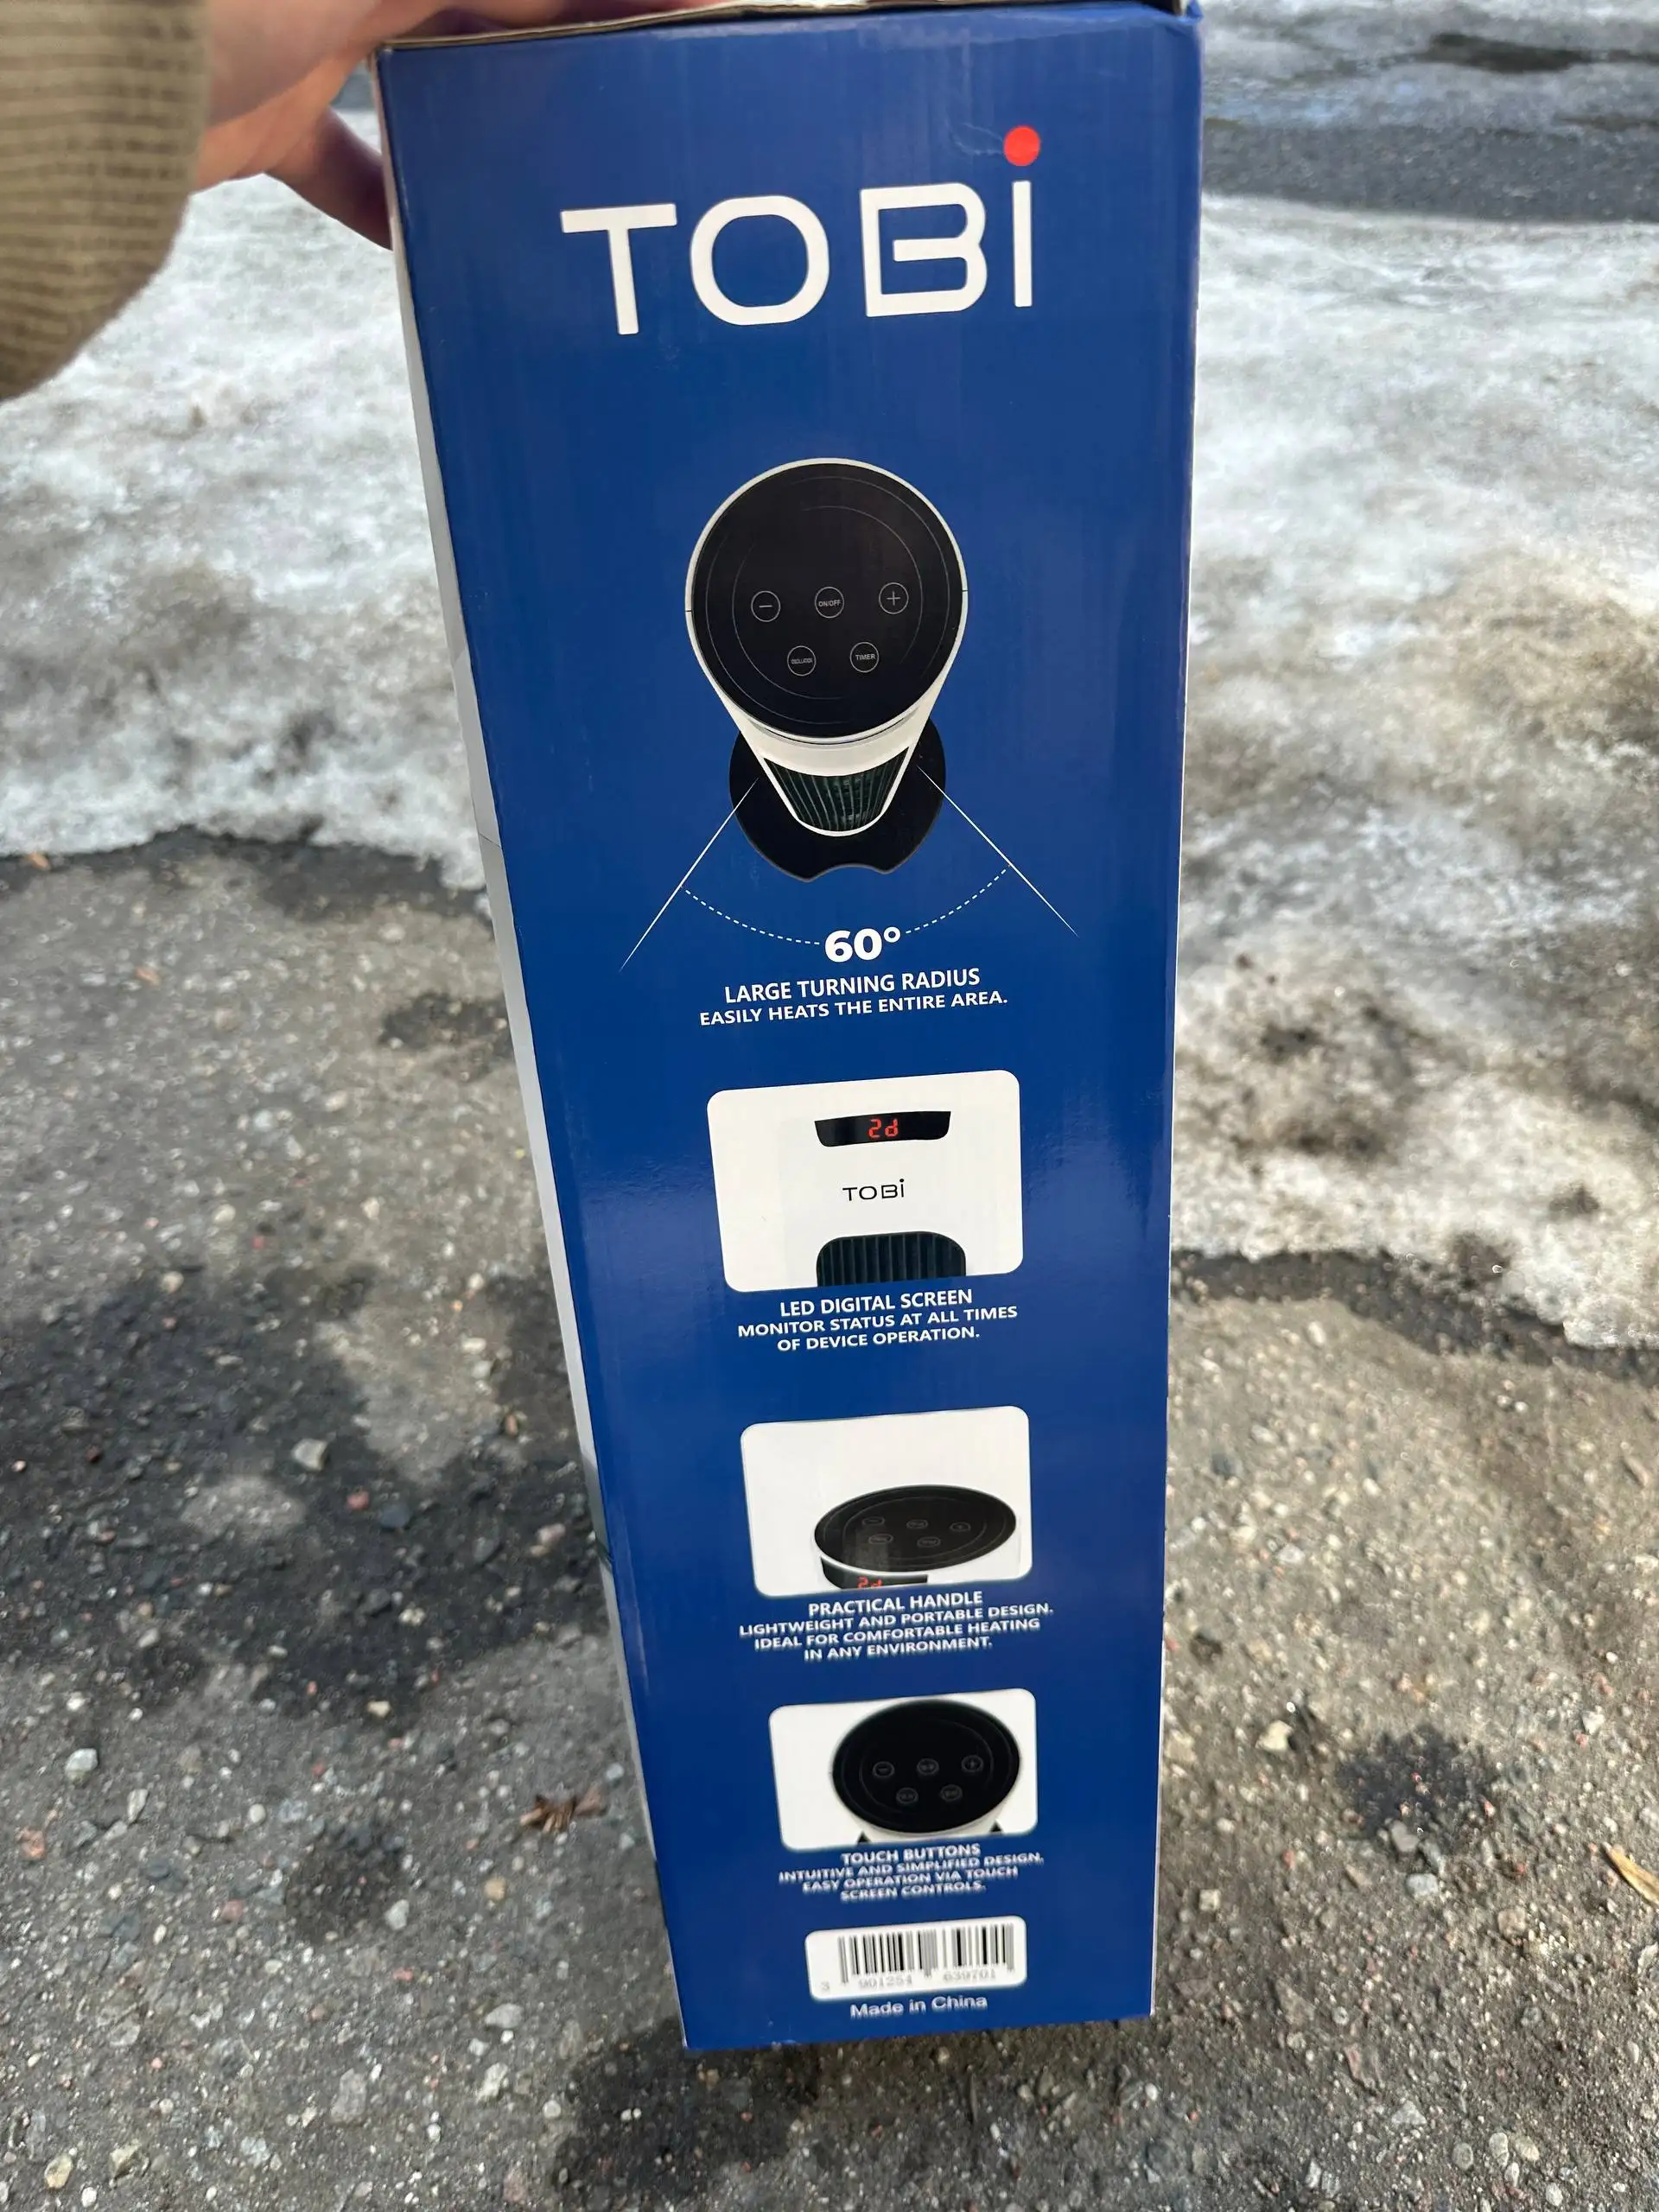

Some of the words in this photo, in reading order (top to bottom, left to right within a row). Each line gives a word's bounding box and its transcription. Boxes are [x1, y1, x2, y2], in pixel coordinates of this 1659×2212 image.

[824, 926, 900, 963] 60°
[725, 982, 791, 1003] LARGE
[797, 975, 894, 997] TURNING
[901, 968, 980, 990] RADIUS
[699, 1008, 762, 1027] EASILY
[768, 1004, 830, 1020] HEATS
[834, 1001, 872, 1015] THE
[878, 996, 945, 1013] ENTIRE
[950, 990, 1007, 1007] AREA.
[780, 1300, 815, 1317] LED
[820, 1294, 895, 1313] DIGITAL
[900, 1289, 973, 1309] SCREEN
[737, 1320, 825, 1338] MONITOR
[830, 1315, 895, 1332] STATUS
[899, 1313, 922, 1325] AT
[927, 1311, 959, 1323] ALL
[963, 1306, 1018, 1320] TIMES
[777, 1338, 800, 1352] OF
[806, 1333, 868, 1350] DEVICE
[872, 1326, 981, 1346] OPERATION.
[808, 1597, 905, 1618] PRACTICAL
[909, 1591, 982, 1609] HANDLE
[740, 1618, 855, 1637] LIGHTWEIGHT
[860, 1615, 896, 1628] AND
[900, 1608, 983, 1625] PORTABLE
[988, 1603, 1053, 1618] DESIGN.
[754, 1637, 802, 1651] IDEAL
[806, 1634, 839, 1647] FOR
[843, 1624, 963, 1644] COMFORTABLE
[968, 1618, 1040, 1634] HEATING
[804, 1649, 823, 1663] IN
[827, 1646, 862, 1661] ANY
[867, 1637, 992, 1656] ENVIRONMENT.
[779, 1868, 854, 1885] INTUITIVE
[858, 1865, 893, 1878] AND
[897, 1859, 980, 1874] SIMPLIFIED
[984, 1853, 1044, 1867] DESIGN.
[842, 1850, 899, 1866] TOUCH
[903, 1843, 982, 1859] BUTTONS
[802, 1880, 839, 1895] EASY
[843, 1874, 931, 1891] OPERATION
[935, 1872, 962, 1883] VIA
[964, 1866, 1019, 1880] TOUCH
[841, 1888, 898, 1904] SCREEN
[901, 1881, 986, 1897] CONTROLS.
[850, 2004, 904, 2018] Made
[909, 1999, 926, 2013] in
[931, 1995, 988, 2011] China
